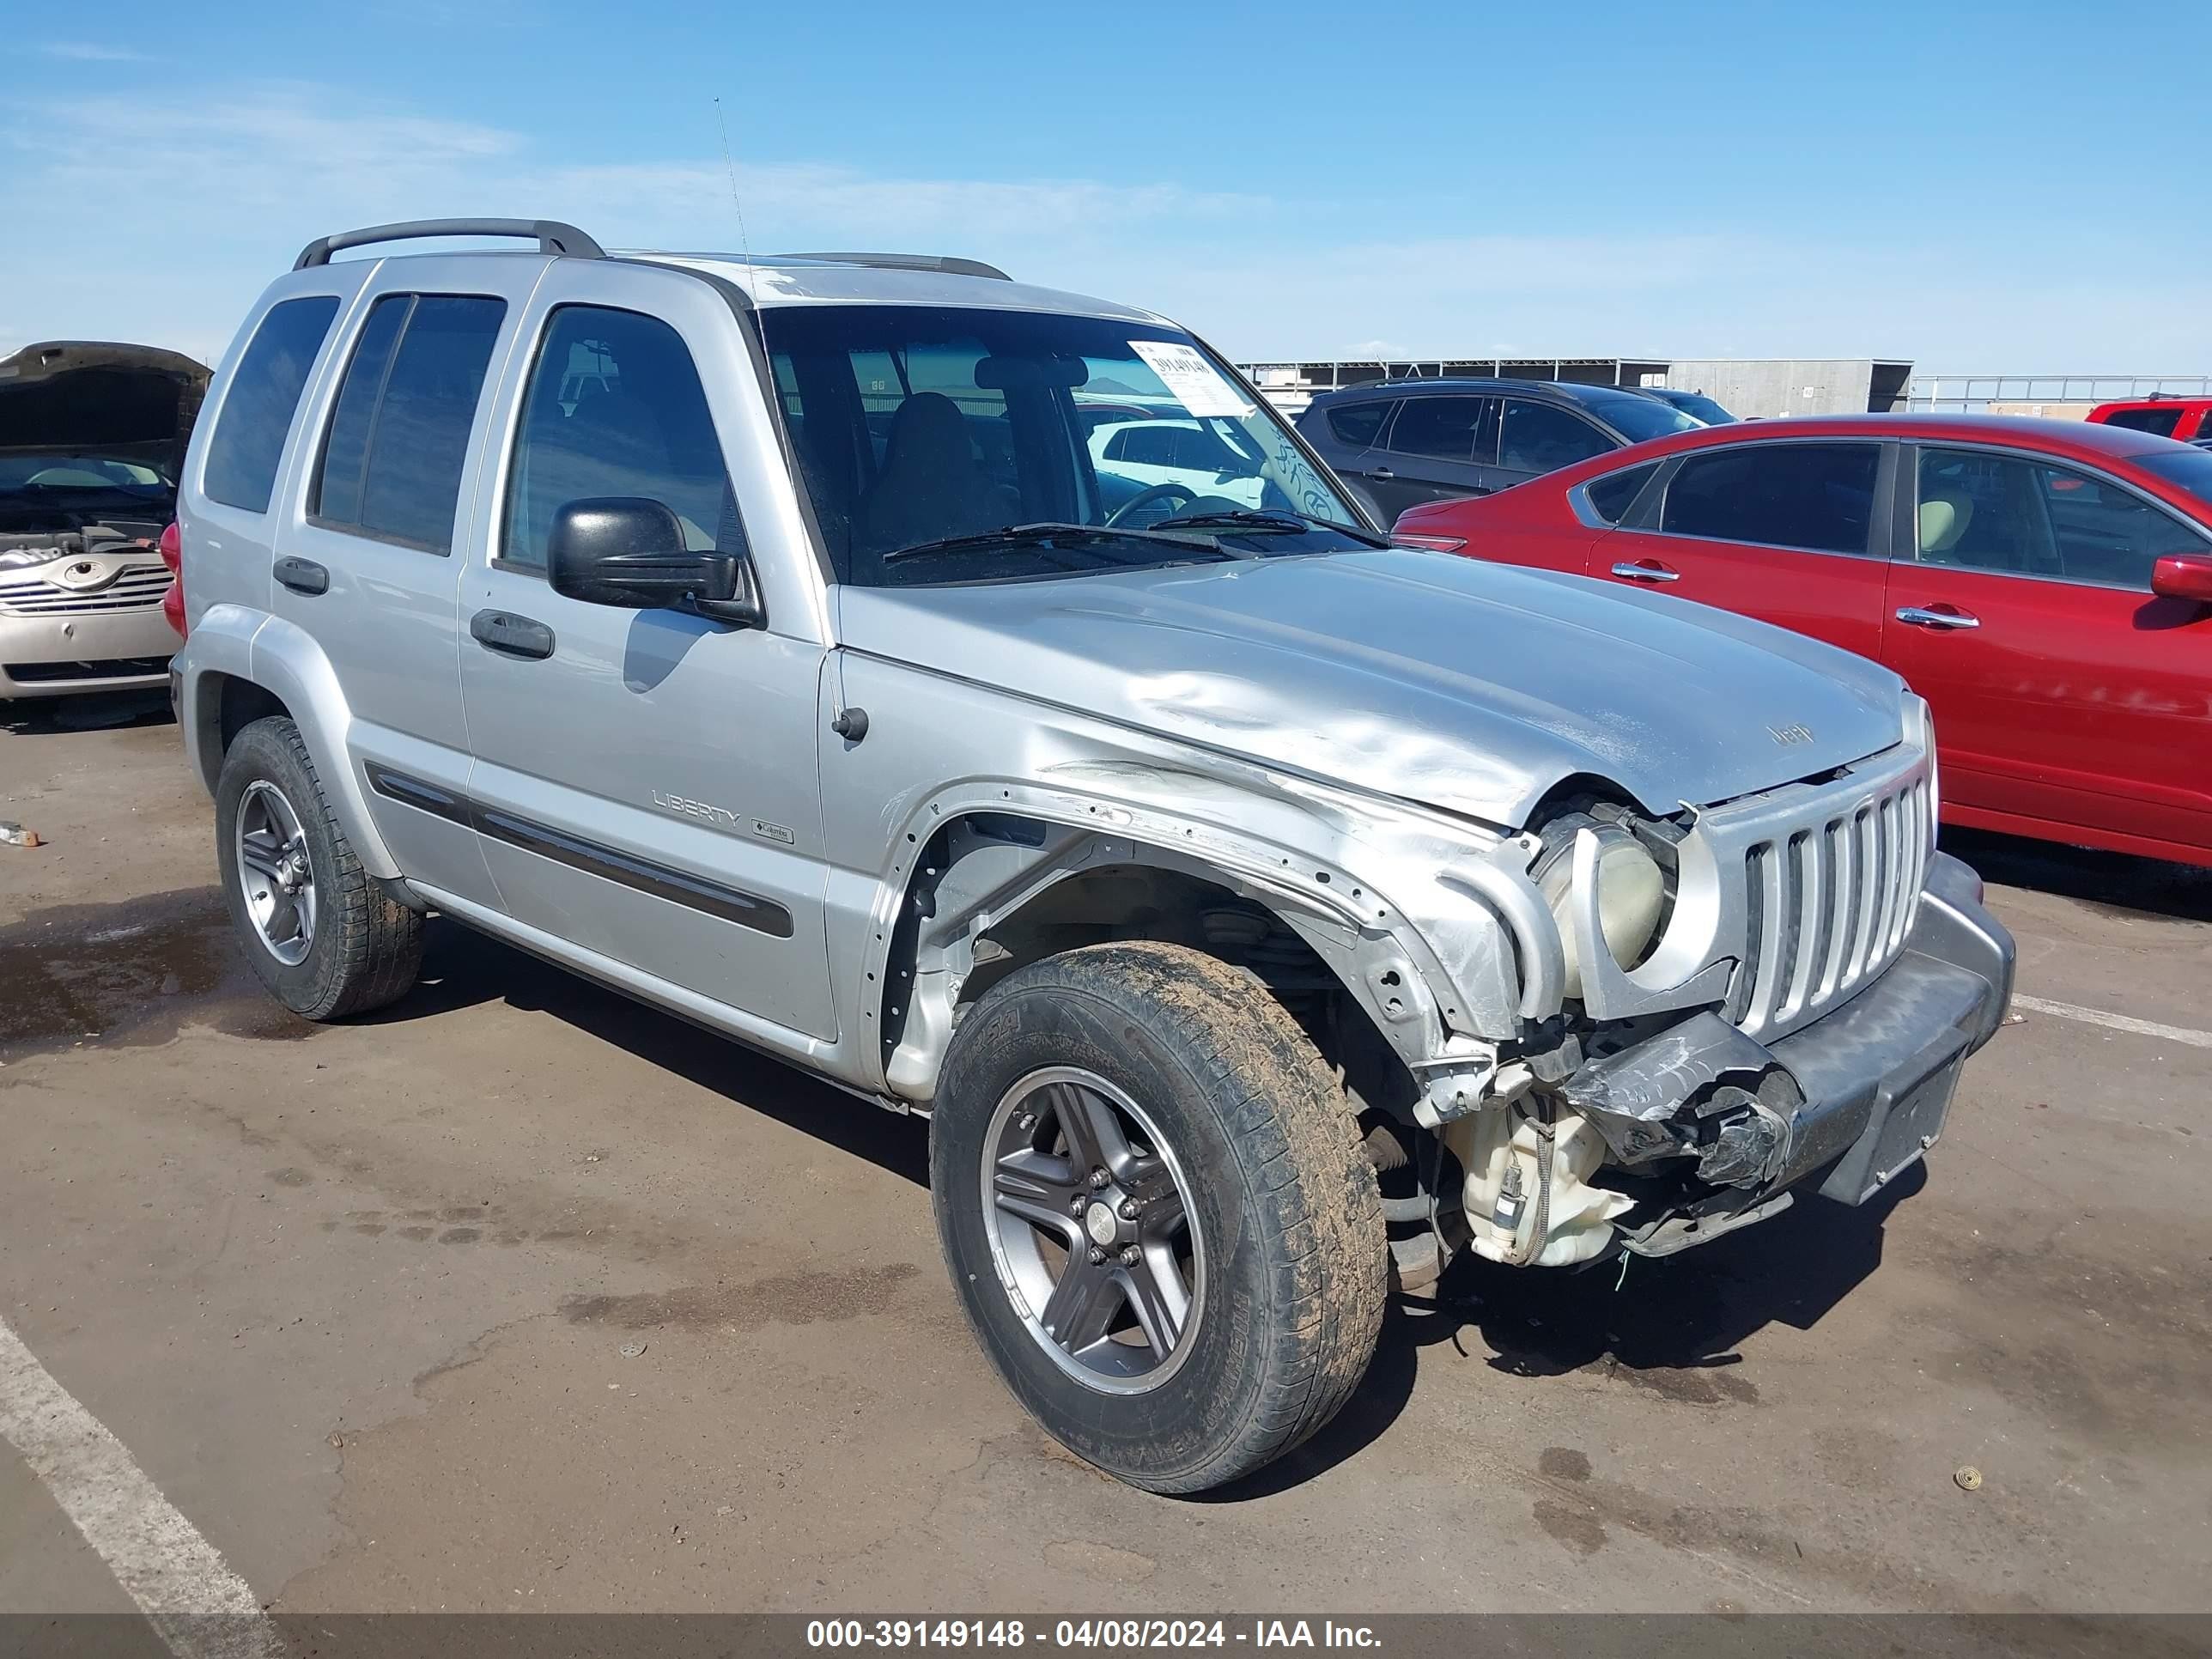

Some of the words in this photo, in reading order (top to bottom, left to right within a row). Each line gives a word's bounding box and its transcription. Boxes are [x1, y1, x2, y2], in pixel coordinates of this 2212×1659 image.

[1152, 357, 1210, 374] 39149148
[1765, 723, 1814, 746] Jeep
[652, 789, 742, 829] LIBERTY
